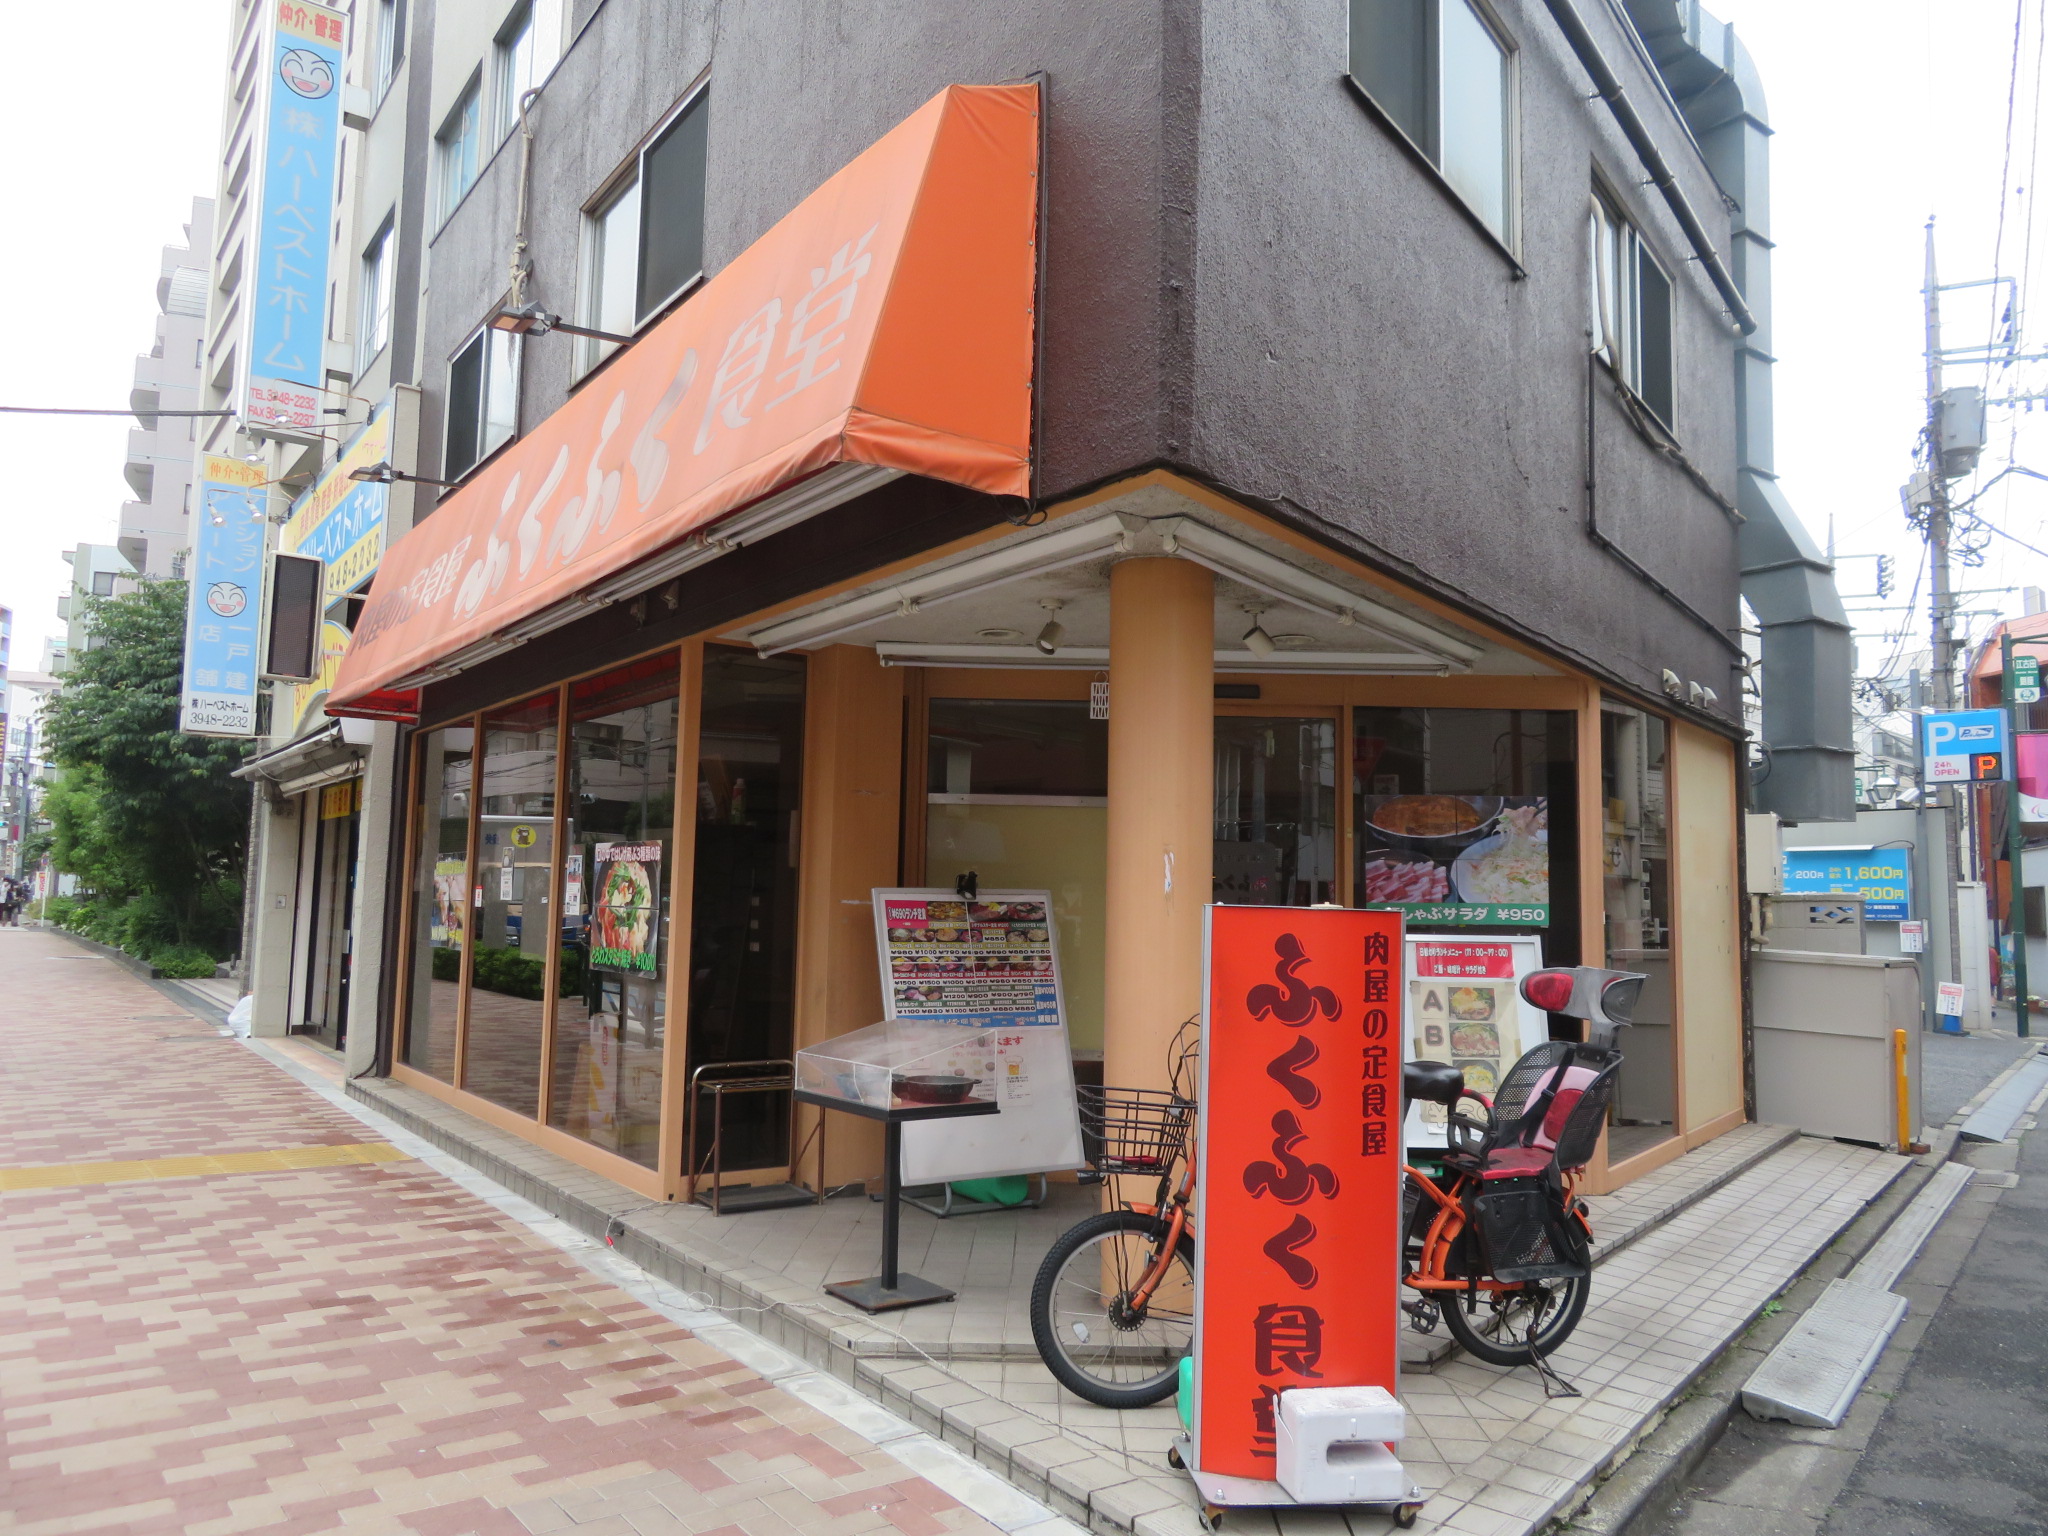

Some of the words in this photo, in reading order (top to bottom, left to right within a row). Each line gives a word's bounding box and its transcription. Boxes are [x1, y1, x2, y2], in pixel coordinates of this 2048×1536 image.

[280, 2, 342, 43] 仲介・管理
[250, 387, 265, 401] TEL
[248, 404, 264, 418] FAX
[266, 406, 315, 427] 39-2237
[453, 222, 880, 620] ふくふく食堂
[233, 494, 260, 572] ンション
[226, 625, 252, 690] 一戸建
[190, 712, 248, 728] 3948-2232
[1928, 721, 1956, 758] P
[1934, 761, 1951, 769] 24h
[1934, 769, 1960, 777] OPEN
[1977, 755, 1996, 779] P
[1845, 866, 1903, 880] 1,600円
[1497, 909, 1545, 921] ¥950
[1423, 989, 1444, 1013] A
[1361, 931, 1389, 1157] 肉屋の定食屋
[1424, 1025, 1445, 1047] B
